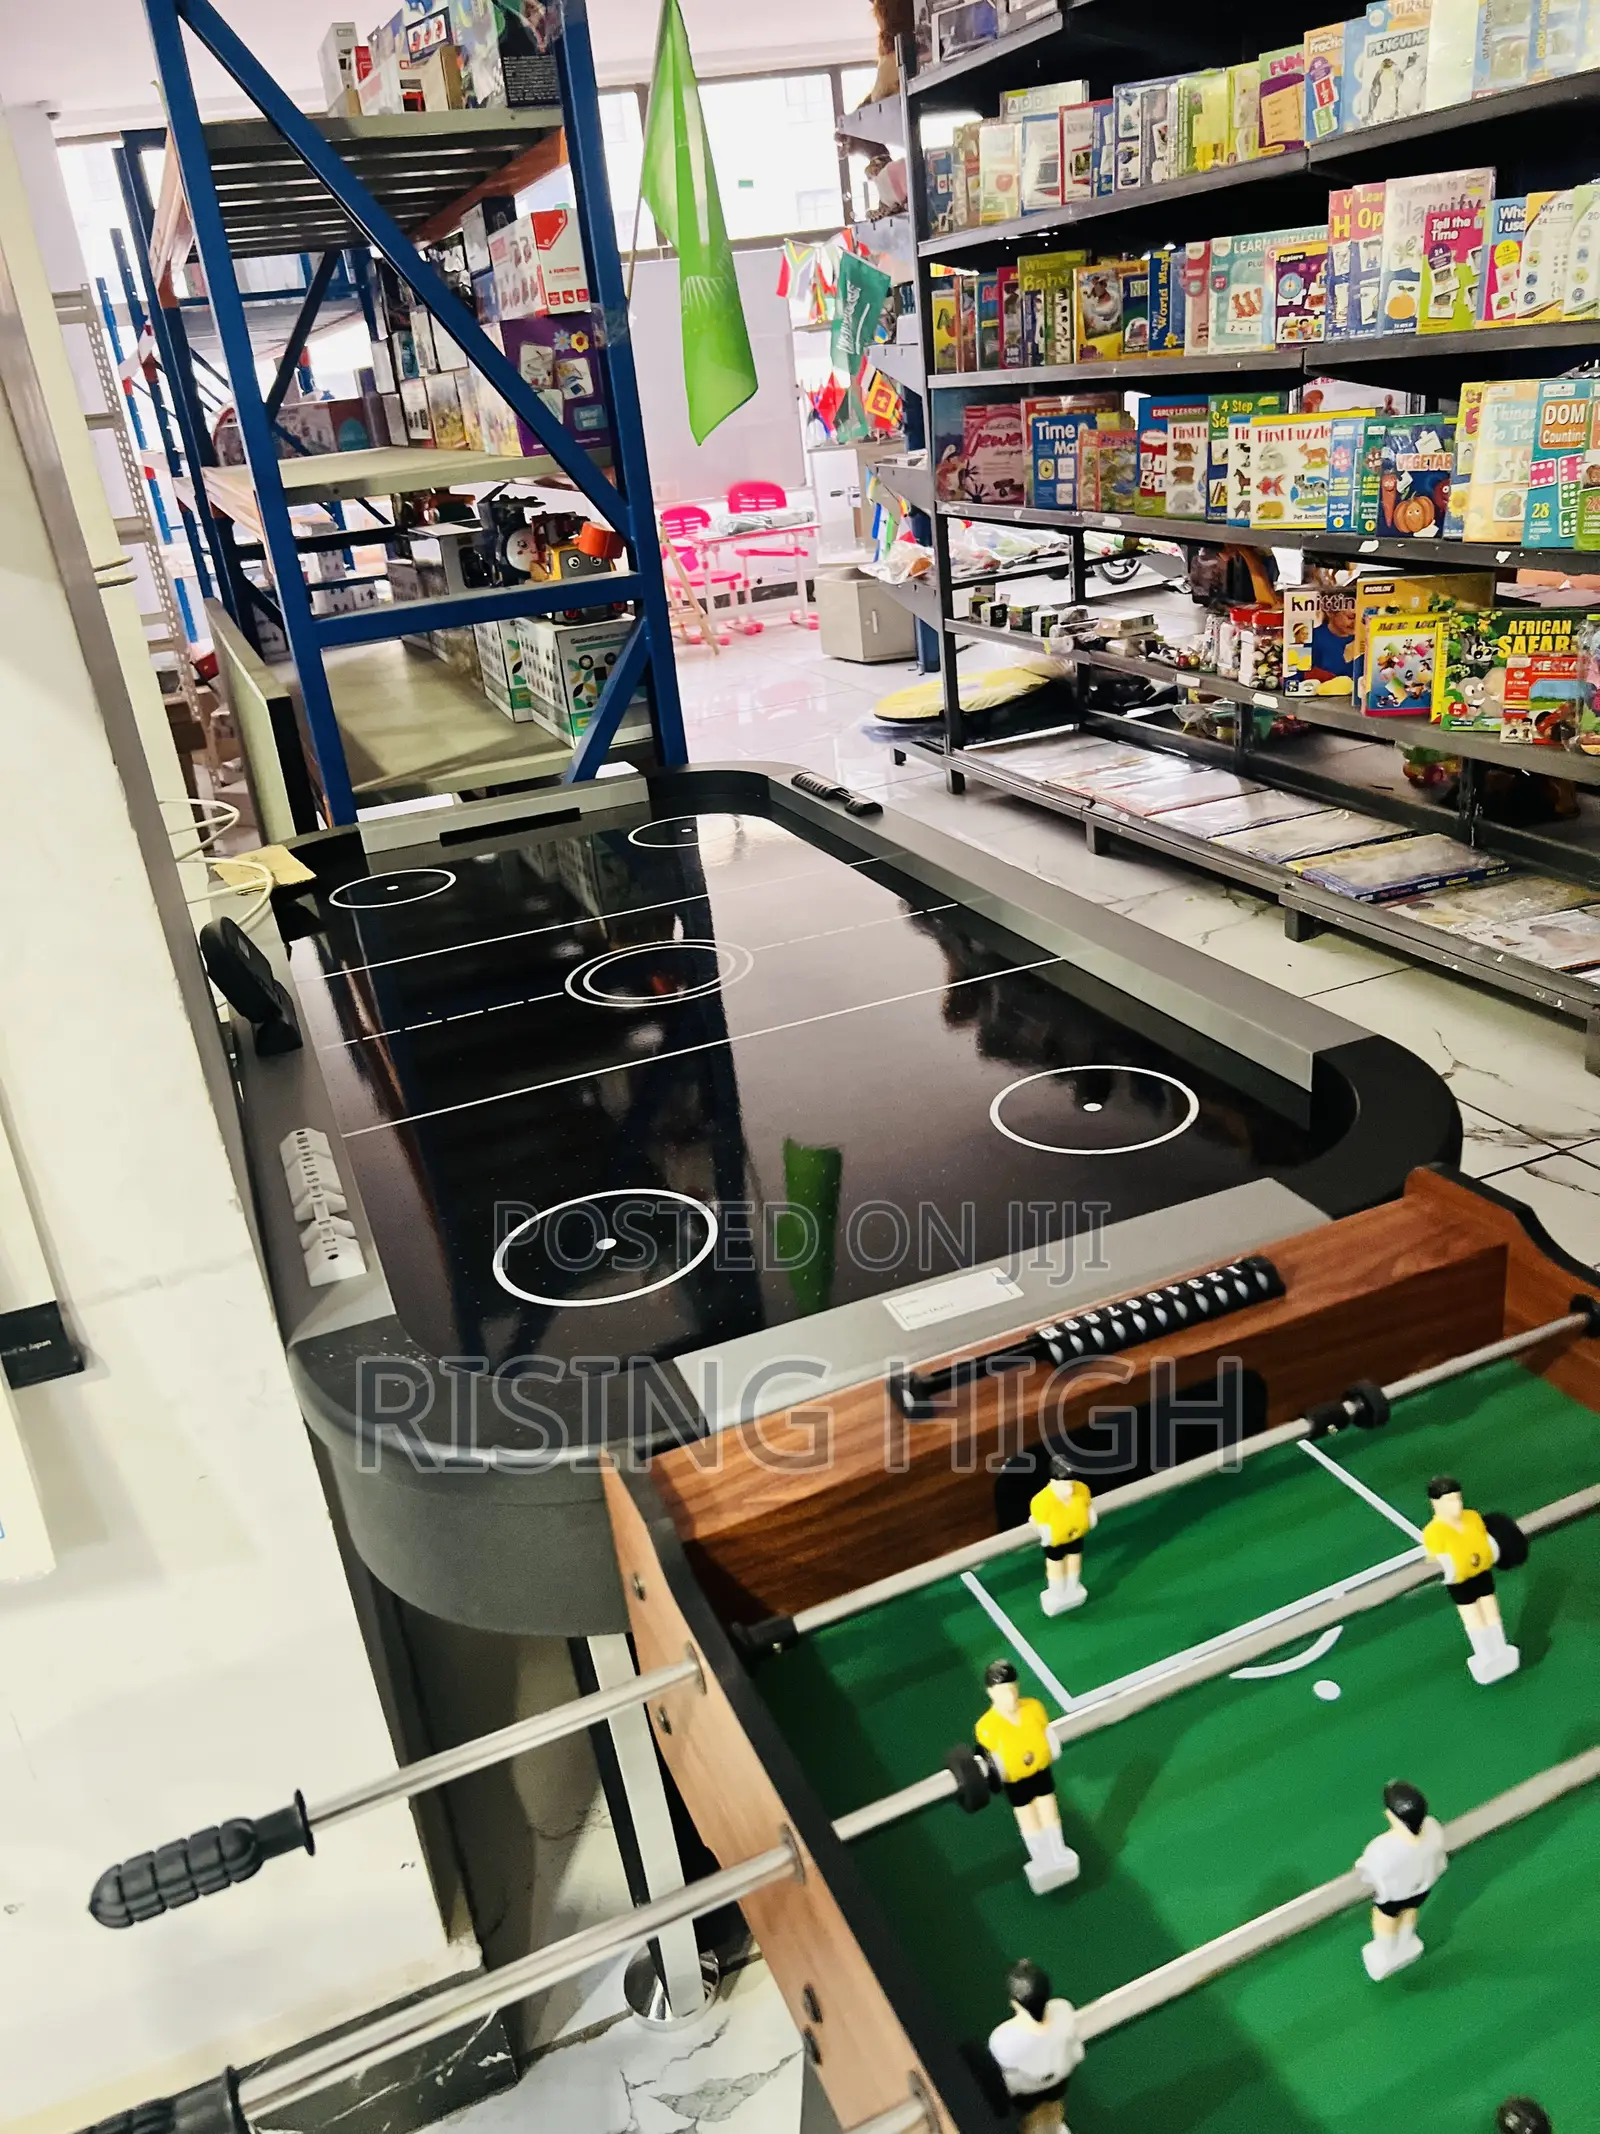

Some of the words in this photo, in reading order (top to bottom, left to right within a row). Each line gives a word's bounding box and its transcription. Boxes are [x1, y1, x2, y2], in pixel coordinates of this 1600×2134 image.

[1431, 217, 1451, 231] Tell
[1452, 215, 1472, 229] the
[1431, 230, 1459, 242] Time
[1035, 420, 1075, 440] Time
[1531, 502, 1550, 519] 28
[1507, 620, 1573, 635] AFRICAN
[29, 1339, 52, 1351] Japan
